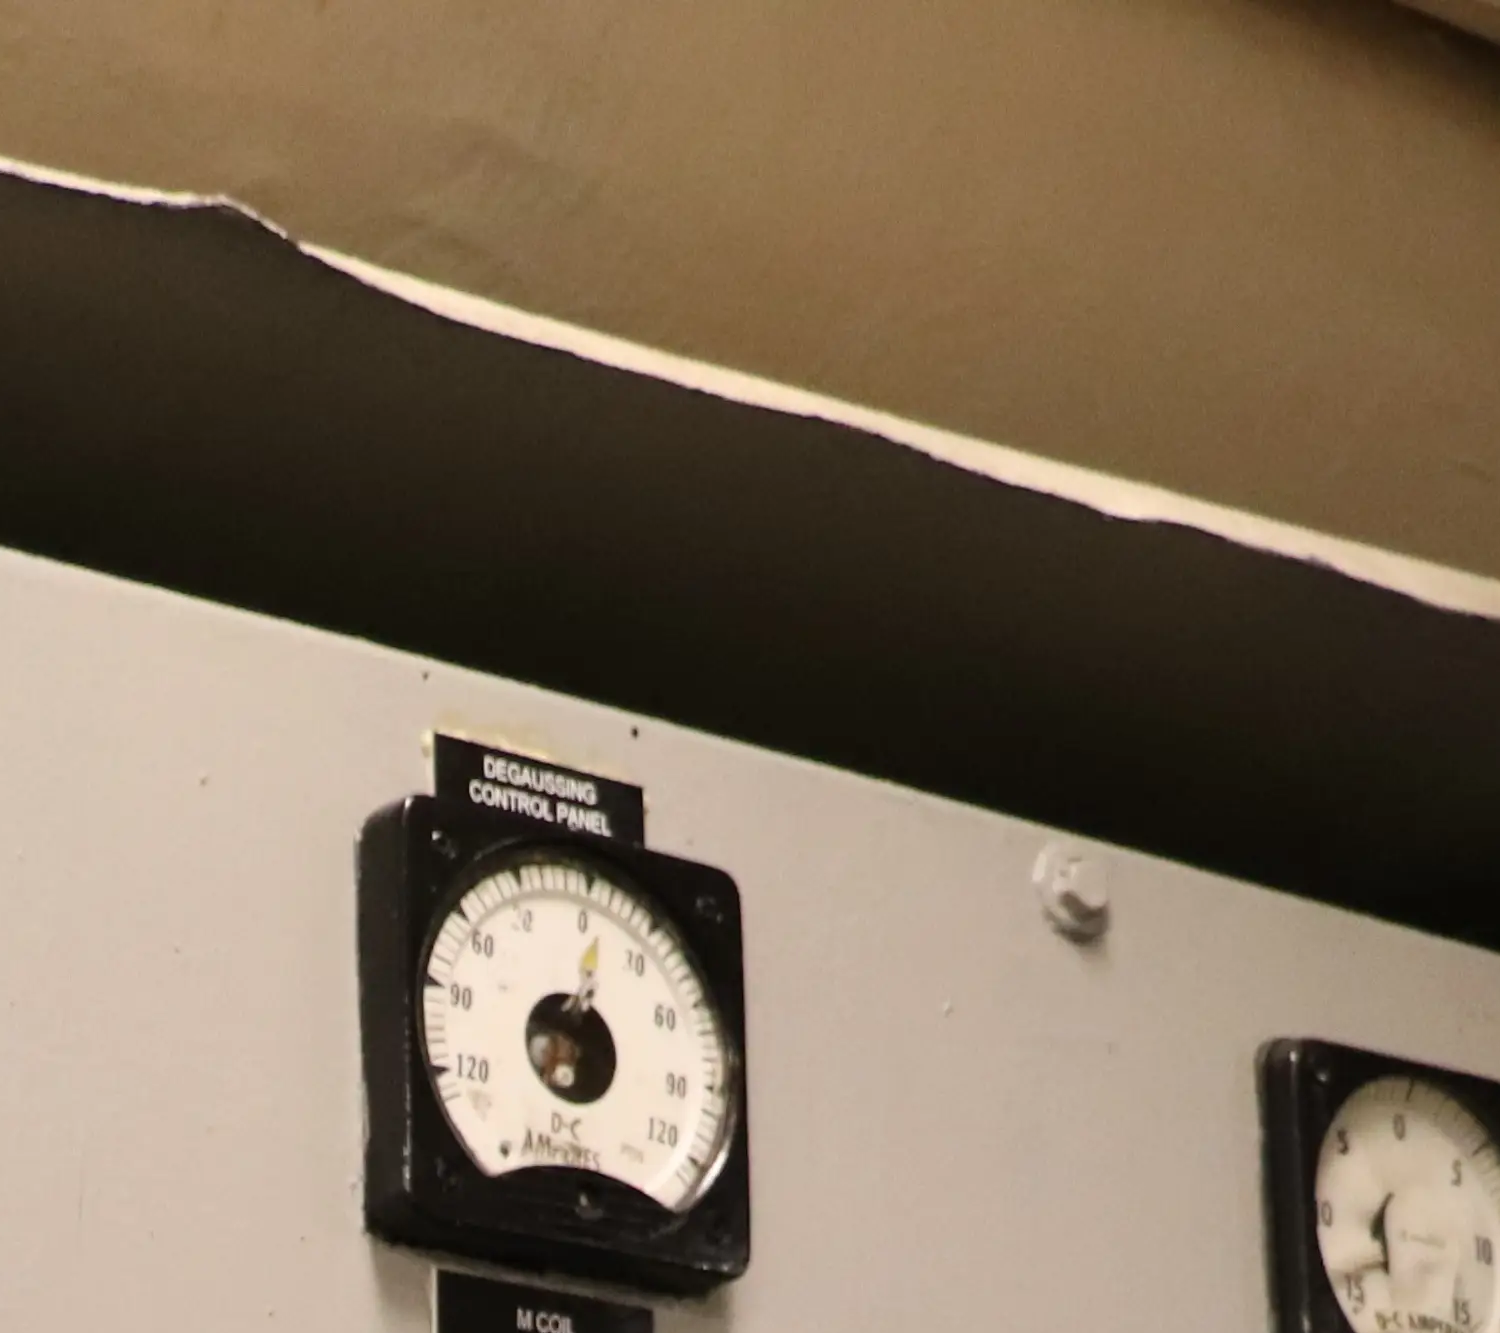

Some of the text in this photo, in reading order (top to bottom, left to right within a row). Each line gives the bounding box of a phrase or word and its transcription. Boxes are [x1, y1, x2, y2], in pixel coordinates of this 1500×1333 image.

[483, 755, 597, 805] DEGAUSSING
[468, 779, 613, 837] CONTROL PANEL
[577, 910, 588, 934] 0
[471, 928, 494, 960] 60
[449, 984, 473, 1011] 90
[654, 1003, 676, 1031] 60
[456, 1054, 489, 1083] 120
[666, 1072, 687, 1099] 90
[647, 1117, 678, 1147] 120
[516, 1306, 533, 1333] M
